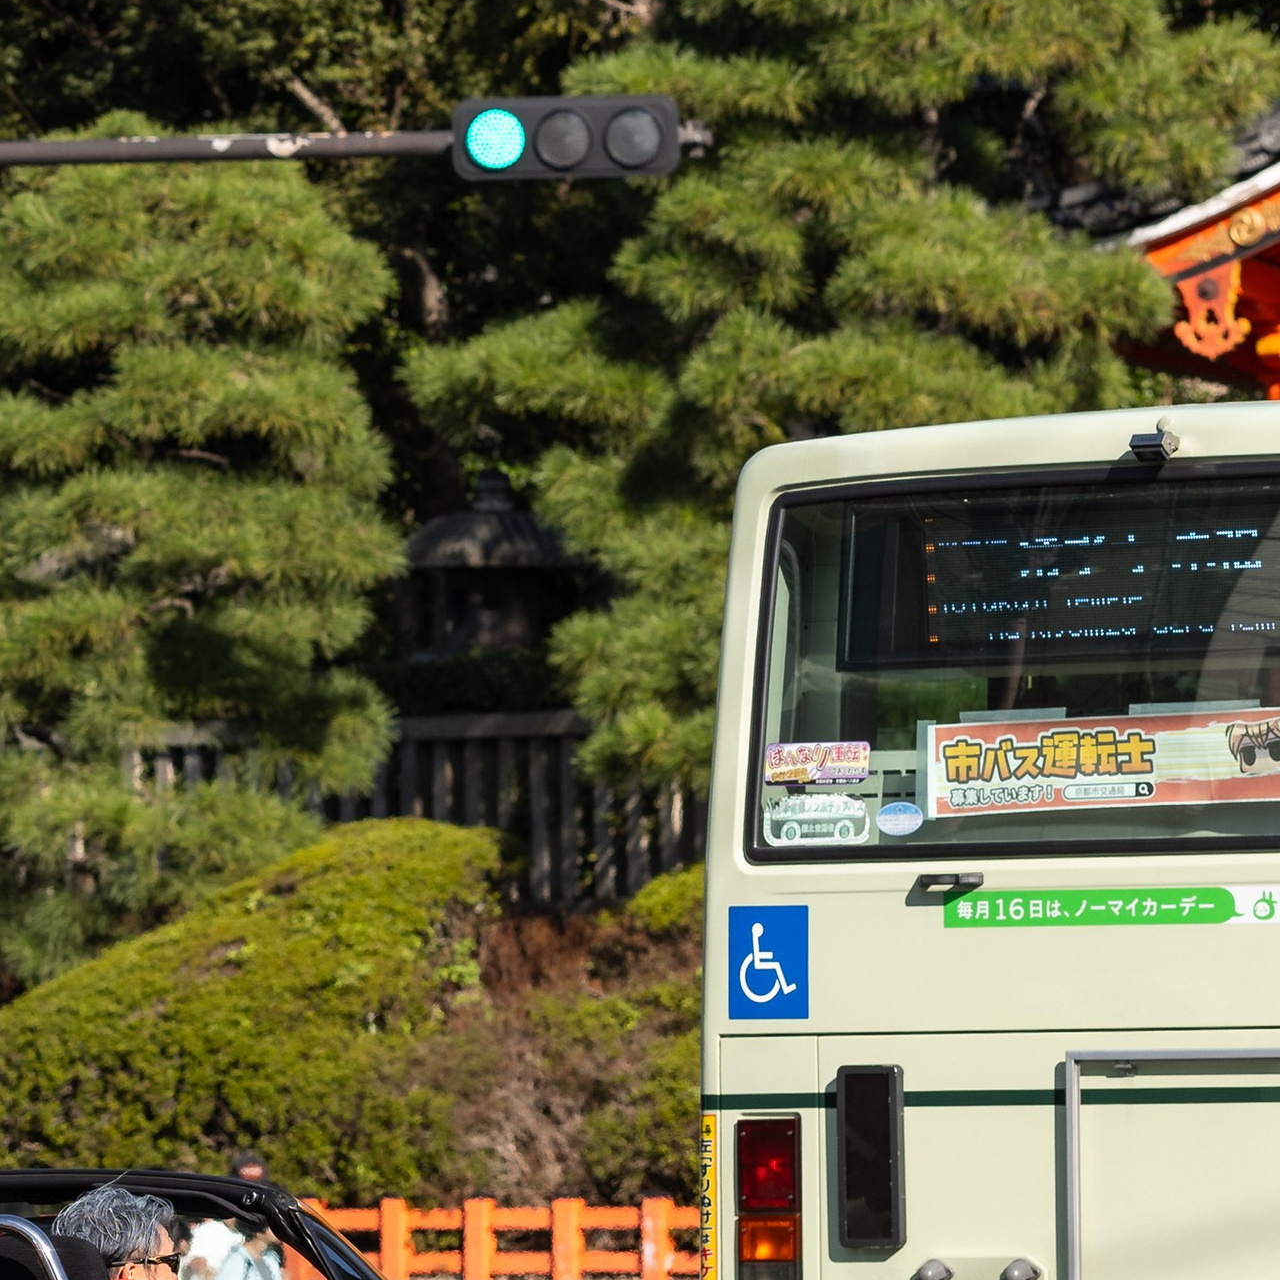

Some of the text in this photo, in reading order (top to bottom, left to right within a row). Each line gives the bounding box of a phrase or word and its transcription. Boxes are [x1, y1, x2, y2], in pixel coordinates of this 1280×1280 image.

[943, 731, 1156, 783] 市バス運転士
[950, 784, 1053, 807] 募集しています！
[956, 895, 1215, 921] 毎月16日は、ノーマイカーデー
